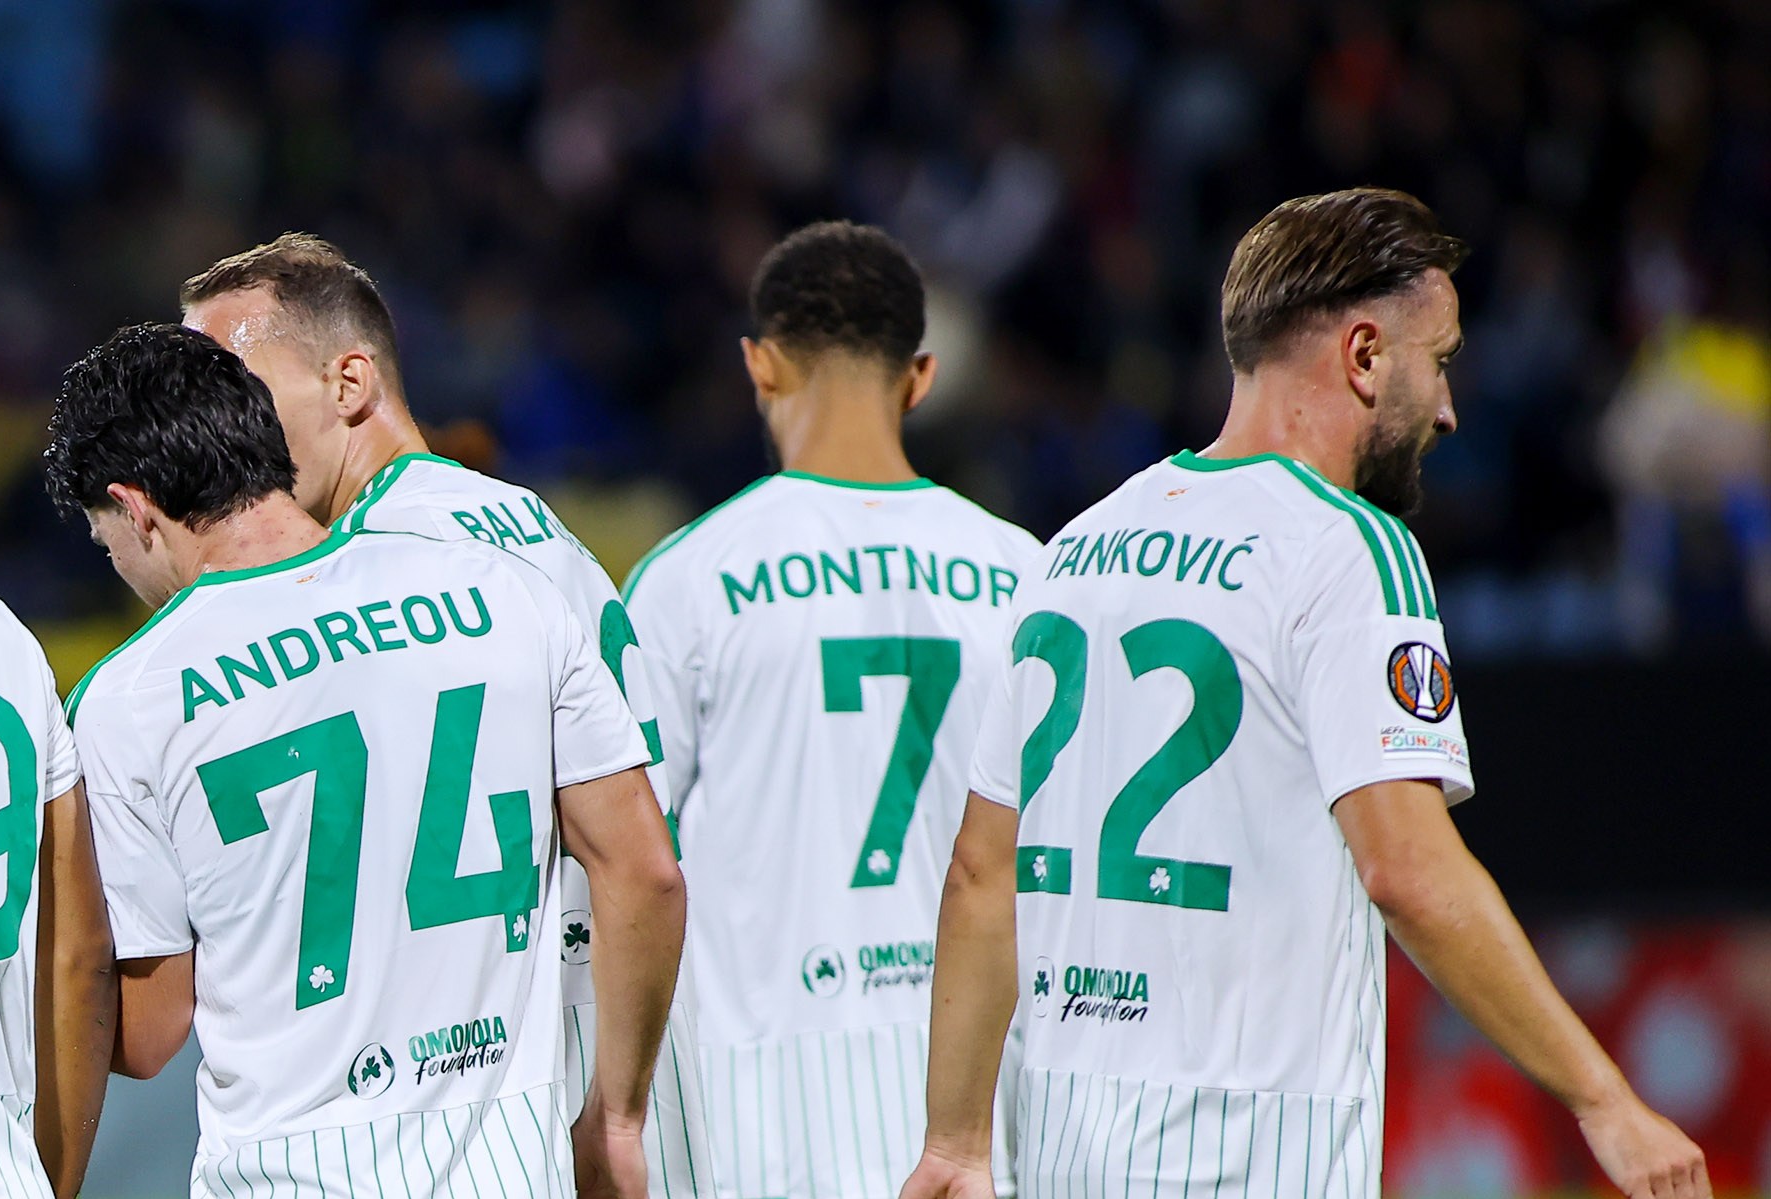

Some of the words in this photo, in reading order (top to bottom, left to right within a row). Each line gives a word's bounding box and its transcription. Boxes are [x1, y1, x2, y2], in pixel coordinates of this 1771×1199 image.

[180, 586, 493, 724] ANDREOU
[719, 545, 1018, 615] MONTNOR
[1045, 527, 1259, 591] TANKOVIĆ
[196, 682, 540, 1011] 74
[820, 635, 961, 889] 7
[1012, 611, 1244, 912] 22
